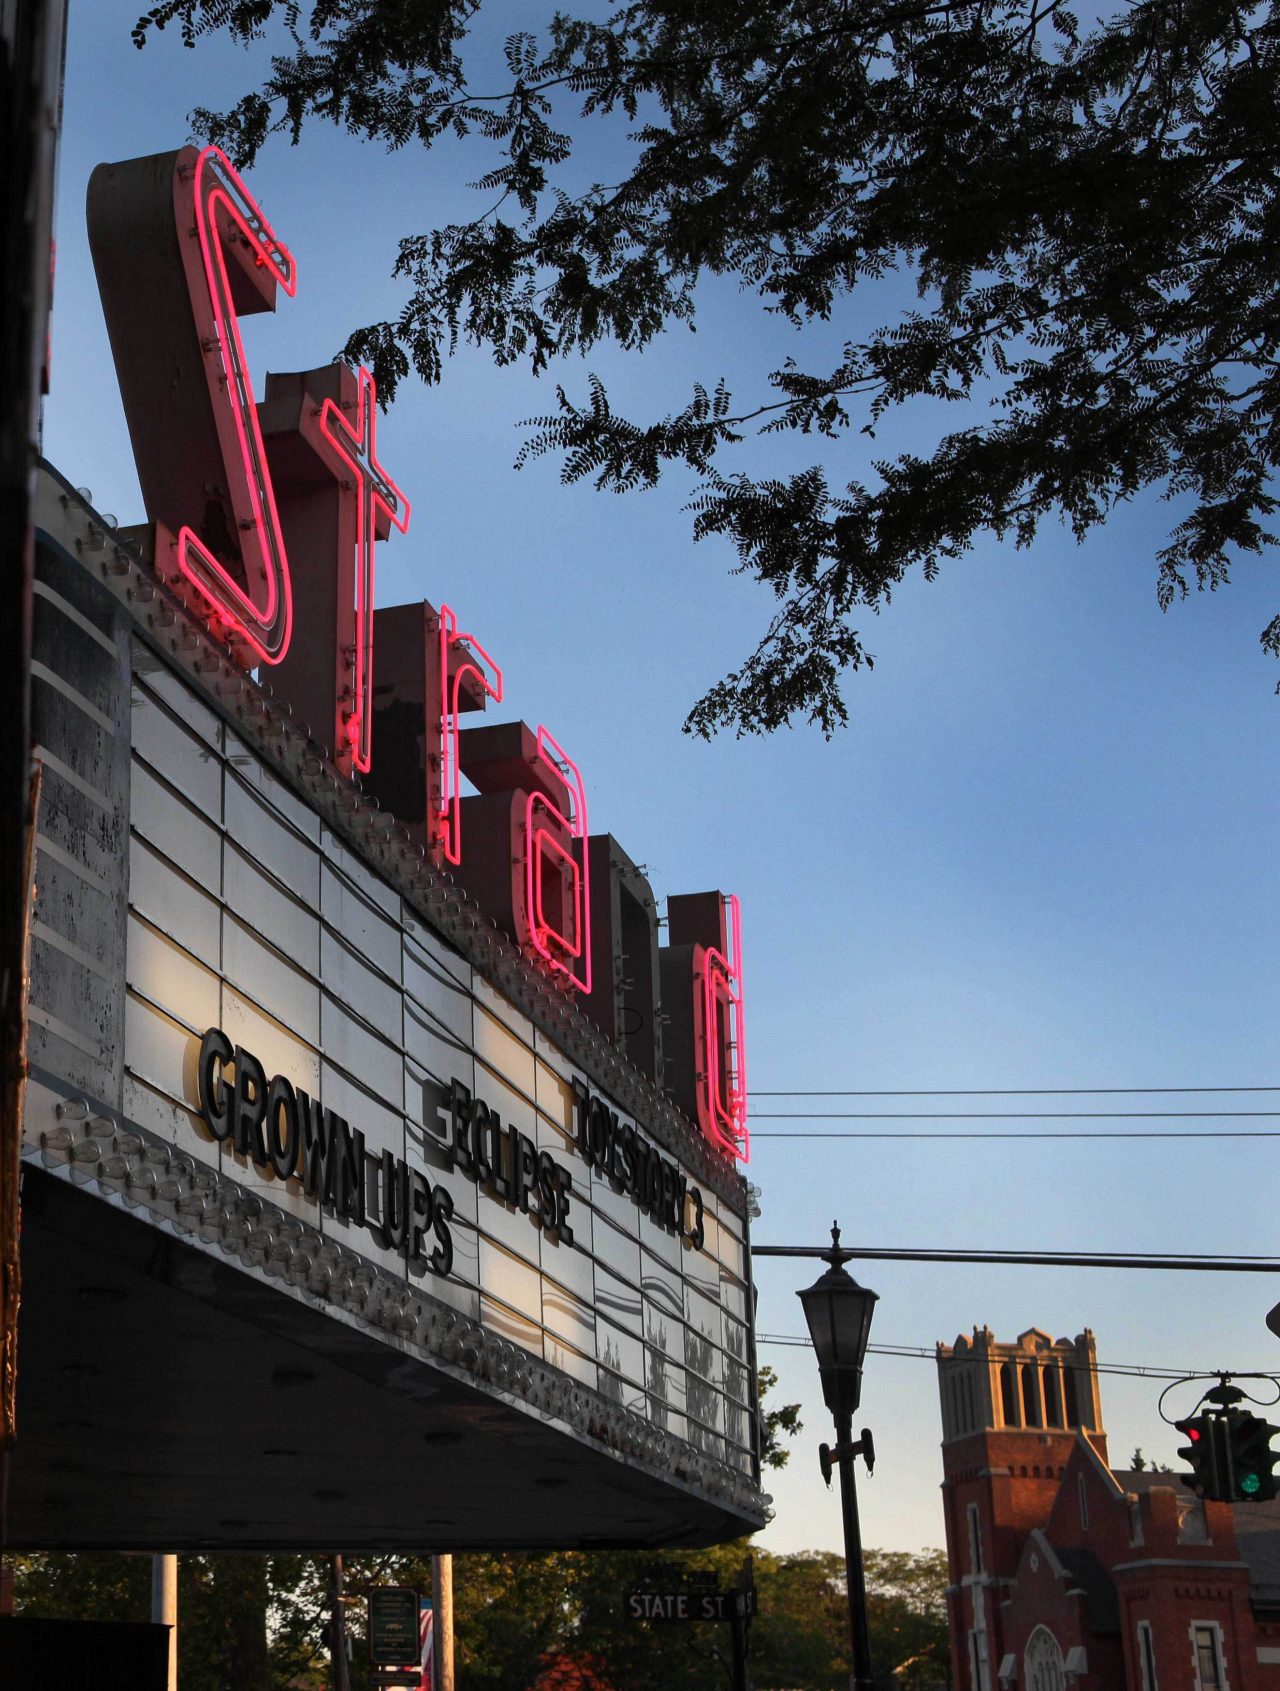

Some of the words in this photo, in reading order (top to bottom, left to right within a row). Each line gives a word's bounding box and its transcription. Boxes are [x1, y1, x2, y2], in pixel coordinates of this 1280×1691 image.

[199, 1026, 366, 1228] GROWN
[372, 1149, 455, 1278] UPS
[450, 1076, 574, 1248] ECLIPSE
[572, 1075, 619, 1175] TOY
[684, 1187, 704, 1251] 3
[628, 1594, 688, 1618] STATE
[701, 1596, 725, 1618] ST
